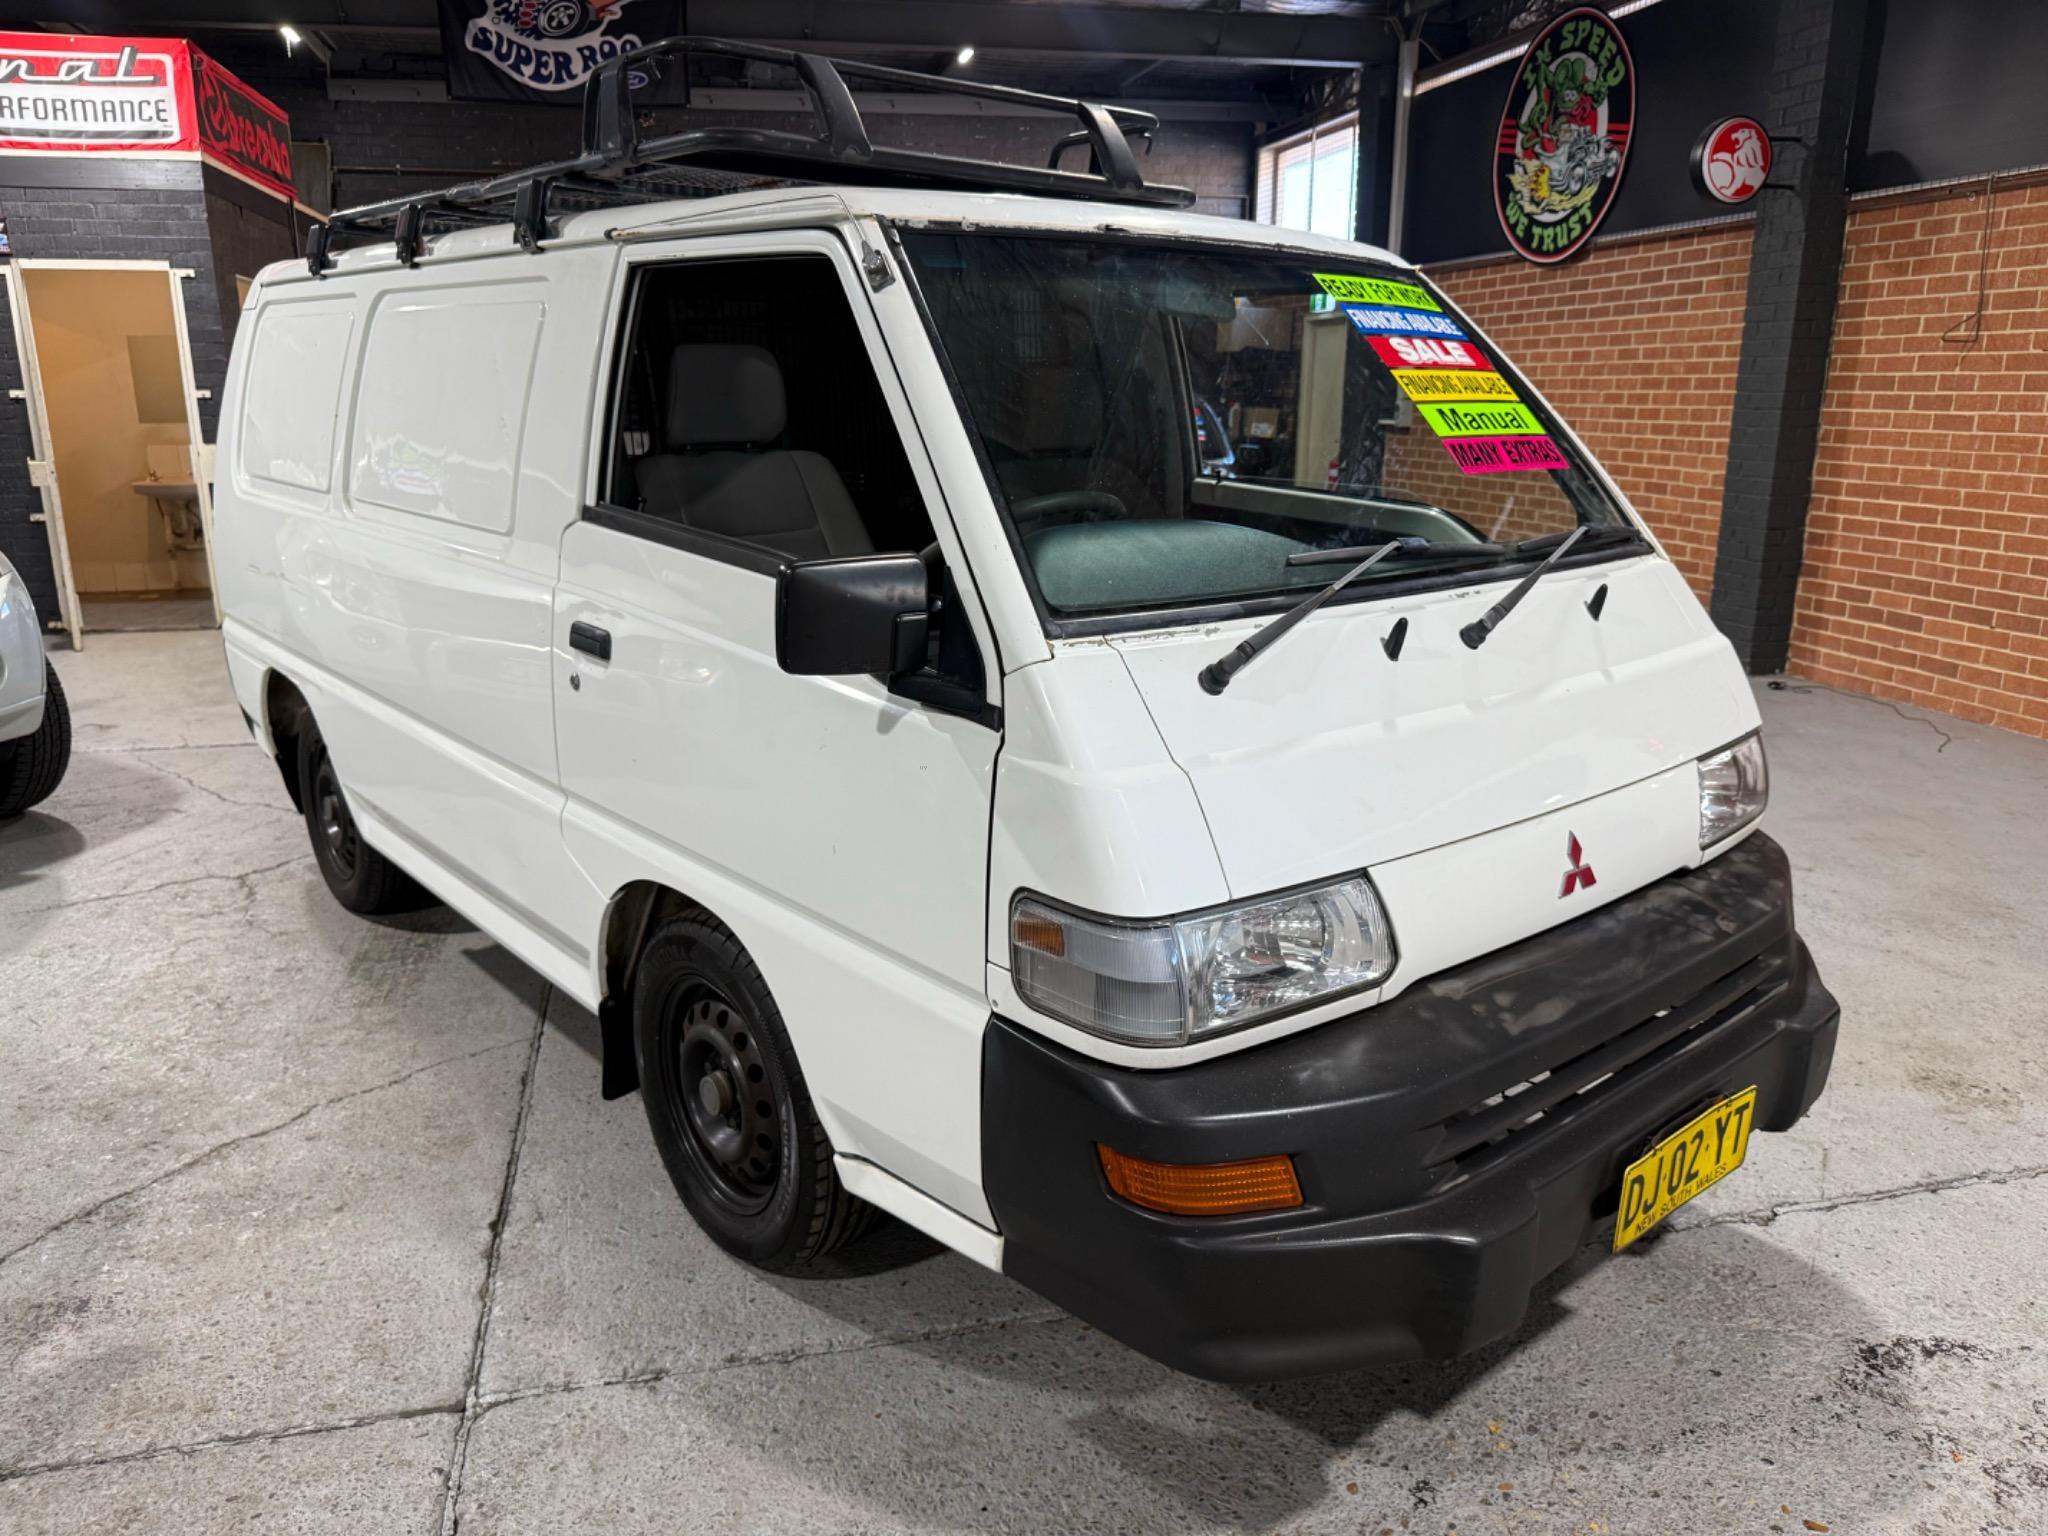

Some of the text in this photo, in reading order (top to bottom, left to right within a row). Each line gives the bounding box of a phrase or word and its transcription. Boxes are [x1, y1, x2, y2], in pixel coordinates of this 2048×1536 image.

[472, 27, 578, 84] SUPER
[1560, 19, 1625, 87] SPEED
[1506, 191, 1592, 253] WE TRUST
[1320, 278, 1368, 299] READY
[1367, 281, 1396, 302] FOR
[1347, 309, 1410, 330] FINANCING
[1388, 338, 1476, 367] SALE
[1399, 375, 1512, 395] FINANCING AVAILABLE
[1436, 408, 1530, 432] Manual
[1450, 440, 1561, 468] MANY EXTRAS
[1622, 1101, 1750, 1231] DJ 02 YT
[1660, 1187, 1692, 1216] SOUTH
[1696, 1162, 1727, 1191] WALES
